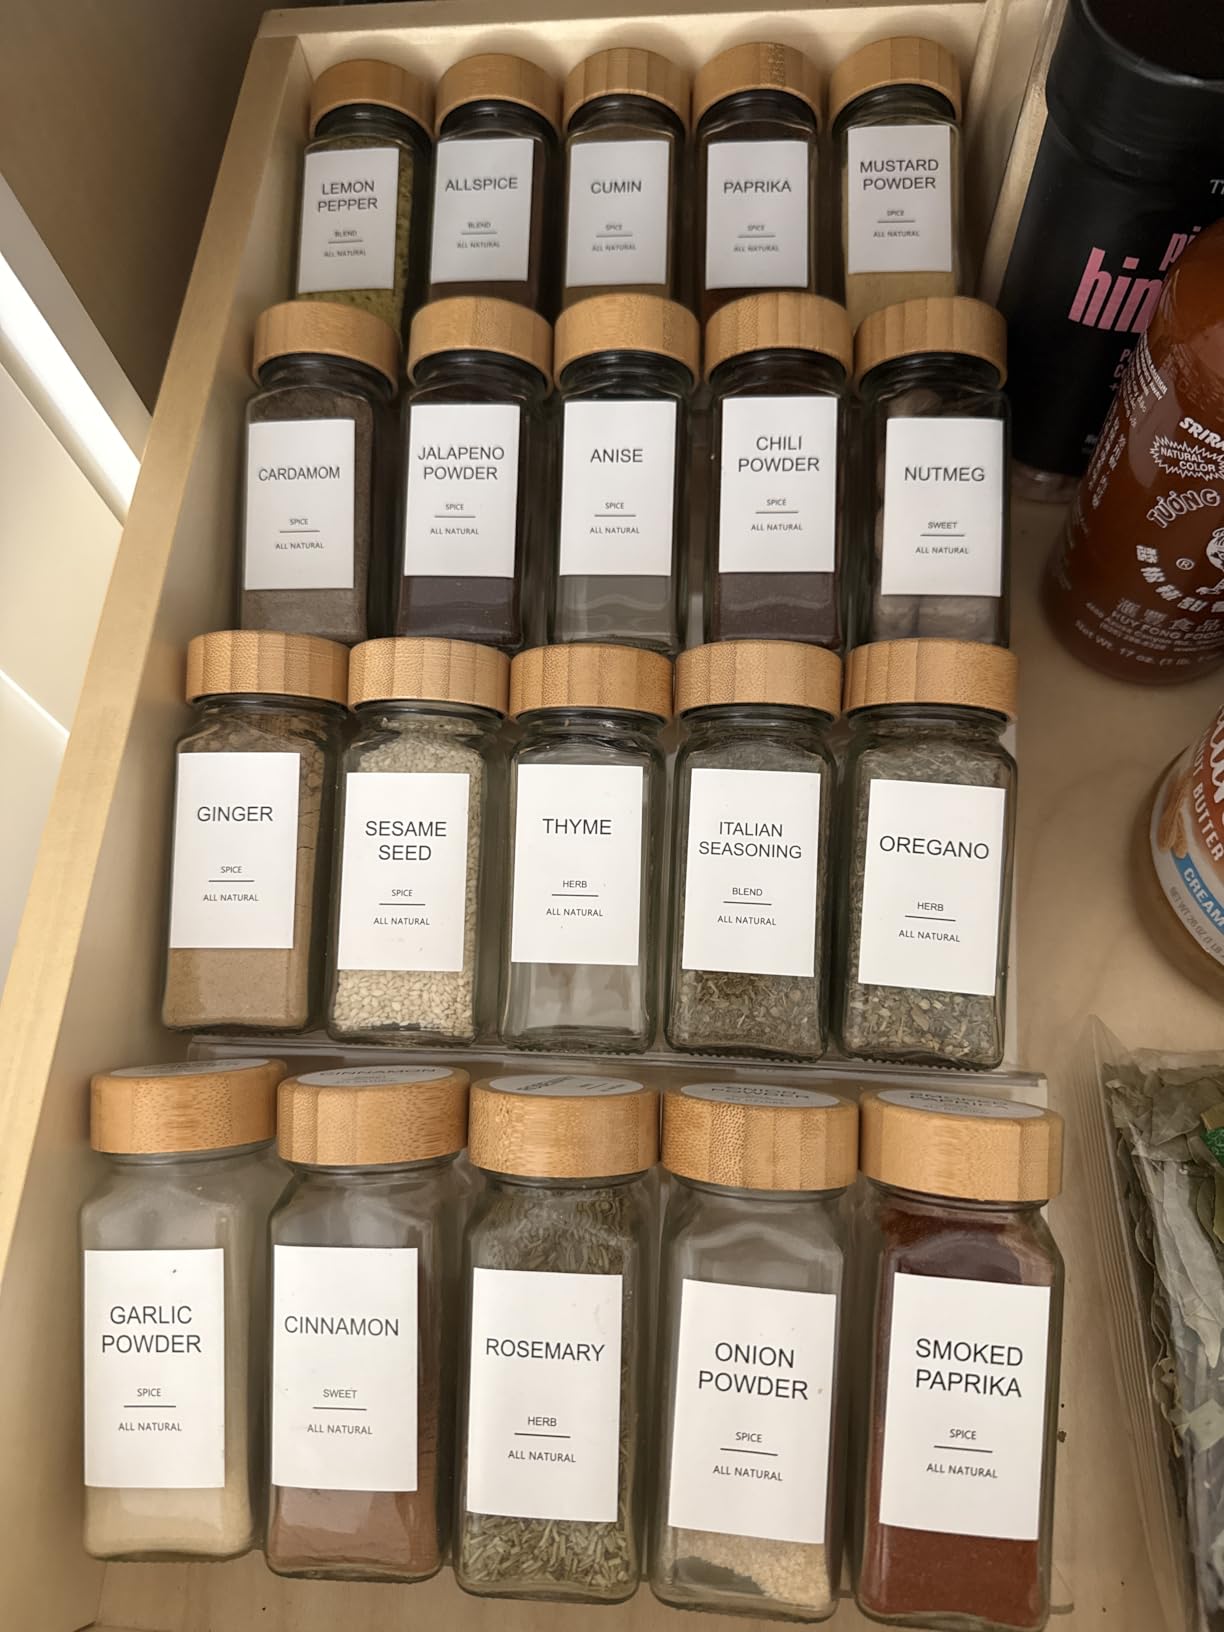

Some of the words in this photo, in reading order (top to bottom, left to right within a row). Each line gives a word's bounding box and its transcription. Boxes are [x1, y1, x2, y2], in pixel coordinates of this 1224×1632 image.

[860, 158, 939, 175] MUSTARD
[322, 179, 374, 195] LEMON
[445, 176, 518, 192] ALLSPICE
[590, 180, 642, 194] CUMIN
[723, 179, 792, 194] PAPRIKA
[863, 173, 936, 191] POWDER
[317, 195, 378, 213] PEPPER
[756, 435, 802, 452] CHILI
[416, 444, 504, 463] JALAPENO
[590, 448, 643, 463] ANISE
[1160, 446, 1205, 463] NATURAL
[423, 461, 498, 480] POWDER
[738, 455, 820, 472] POWDER
[1179, 460, 1216, 472] COLOR
[257, 465, 340, 481] CARDAMOM
[904, 466, 985, 482] NUTMEG
[444, 503, 465, 511] SPICE
[604, 501, 625, 511] SPICE
[765, 496, 787, 507] SPICE
[288, 517, 309, 526] SPICE
[750, 523, 764, 532] ALL
[767, 522, 804, 532] NATURAL
[927, 520, 959, 530] SWEET
[429, 527, 443, 536] ALL
[445, 527, 480, 536] NATURAL
[589, 526, 603, 535] ALL
[605, 526, 641, 535] NATURAL
[290, 541, 325, 550] NATURAL
[914, 546, 929, 555] ALL
[932, 546, 970, 555] NATURAL
[1111, 610, 1140, 628] HUY
[1141, 624, 1182, 640] FONG
[197, 806, 273, 822] GINGER
[365, 821, 447, 837] SESAME
[542, 818, 612, 835] THYME
[720, 821, 782, 837] ITALIAN
[1192, 782, 1224, 862] BUTTER
[378, 844, 431, 861] SEED
[699, 841, 801, 859] SEASONING
[880, 835, 990, 859] OREGANO
[219, 865, 243, 874] SPICE
[562, 879, 588, 889] HERB
[731, 886, 764, 897] BLEND
[202, 893, 217, 902] ALL
[220, 893, 260, 902] NATURAL
[391, 888, 414, 898] SPICE
[545, 907, 561, 917] ALL
[564, 907, 605, 918] NATURAL
[916, 900, 945, 912] HERB
[372, 916, 388, 926] ALL
[391, 916, 431, 926] NATURAL
[716, 914, 733, 926] ALL
[736, 913, 777, 927] NATURAL
[898, 929, 915, 939] ALL
[918, 930, 961, 943] NATURAL
[110, 1305, 192, 1325] GARLIC
[284, 1316, 399, 1336] CINNAMON
[102, 1334, 202, 1353] POWDER
[486, 1337, 605, 1362] ROSEMARY
[715, 1342, 794, 1372] ONION
[915, 1338, 1023, 1370] SMOKED
[698, 1370, 808, 1400] POWDER
[916, 1368, 1022, 1398] PAPRIKA
[136, 1387, 163, 1398] SPICE
[322, 1388, 358, 1400] SWEET
[118, 1422, 135, 1431] ALL
[138, 1422, 182, 1432] NATURAL
[527, 1415, 558, 1428] HERB
[307, 1424, 324, 1433] ALL
[327, 1424, 373, 1435] NATURAL
[948, 1428, 977, 1441] SPICE
[734, 1431, 763, 1444] SPICE
[508, 1450, 526, 1460] ALL
[528, 1451, 576, 1464] NATURAL
[712, 1465, 731, 1475] ALL
[734, 1467, 783, 1482] NATURAL
[926, 1463, 945, 1474] ALL
[948, 1465, 998, 1479] NATURAL
